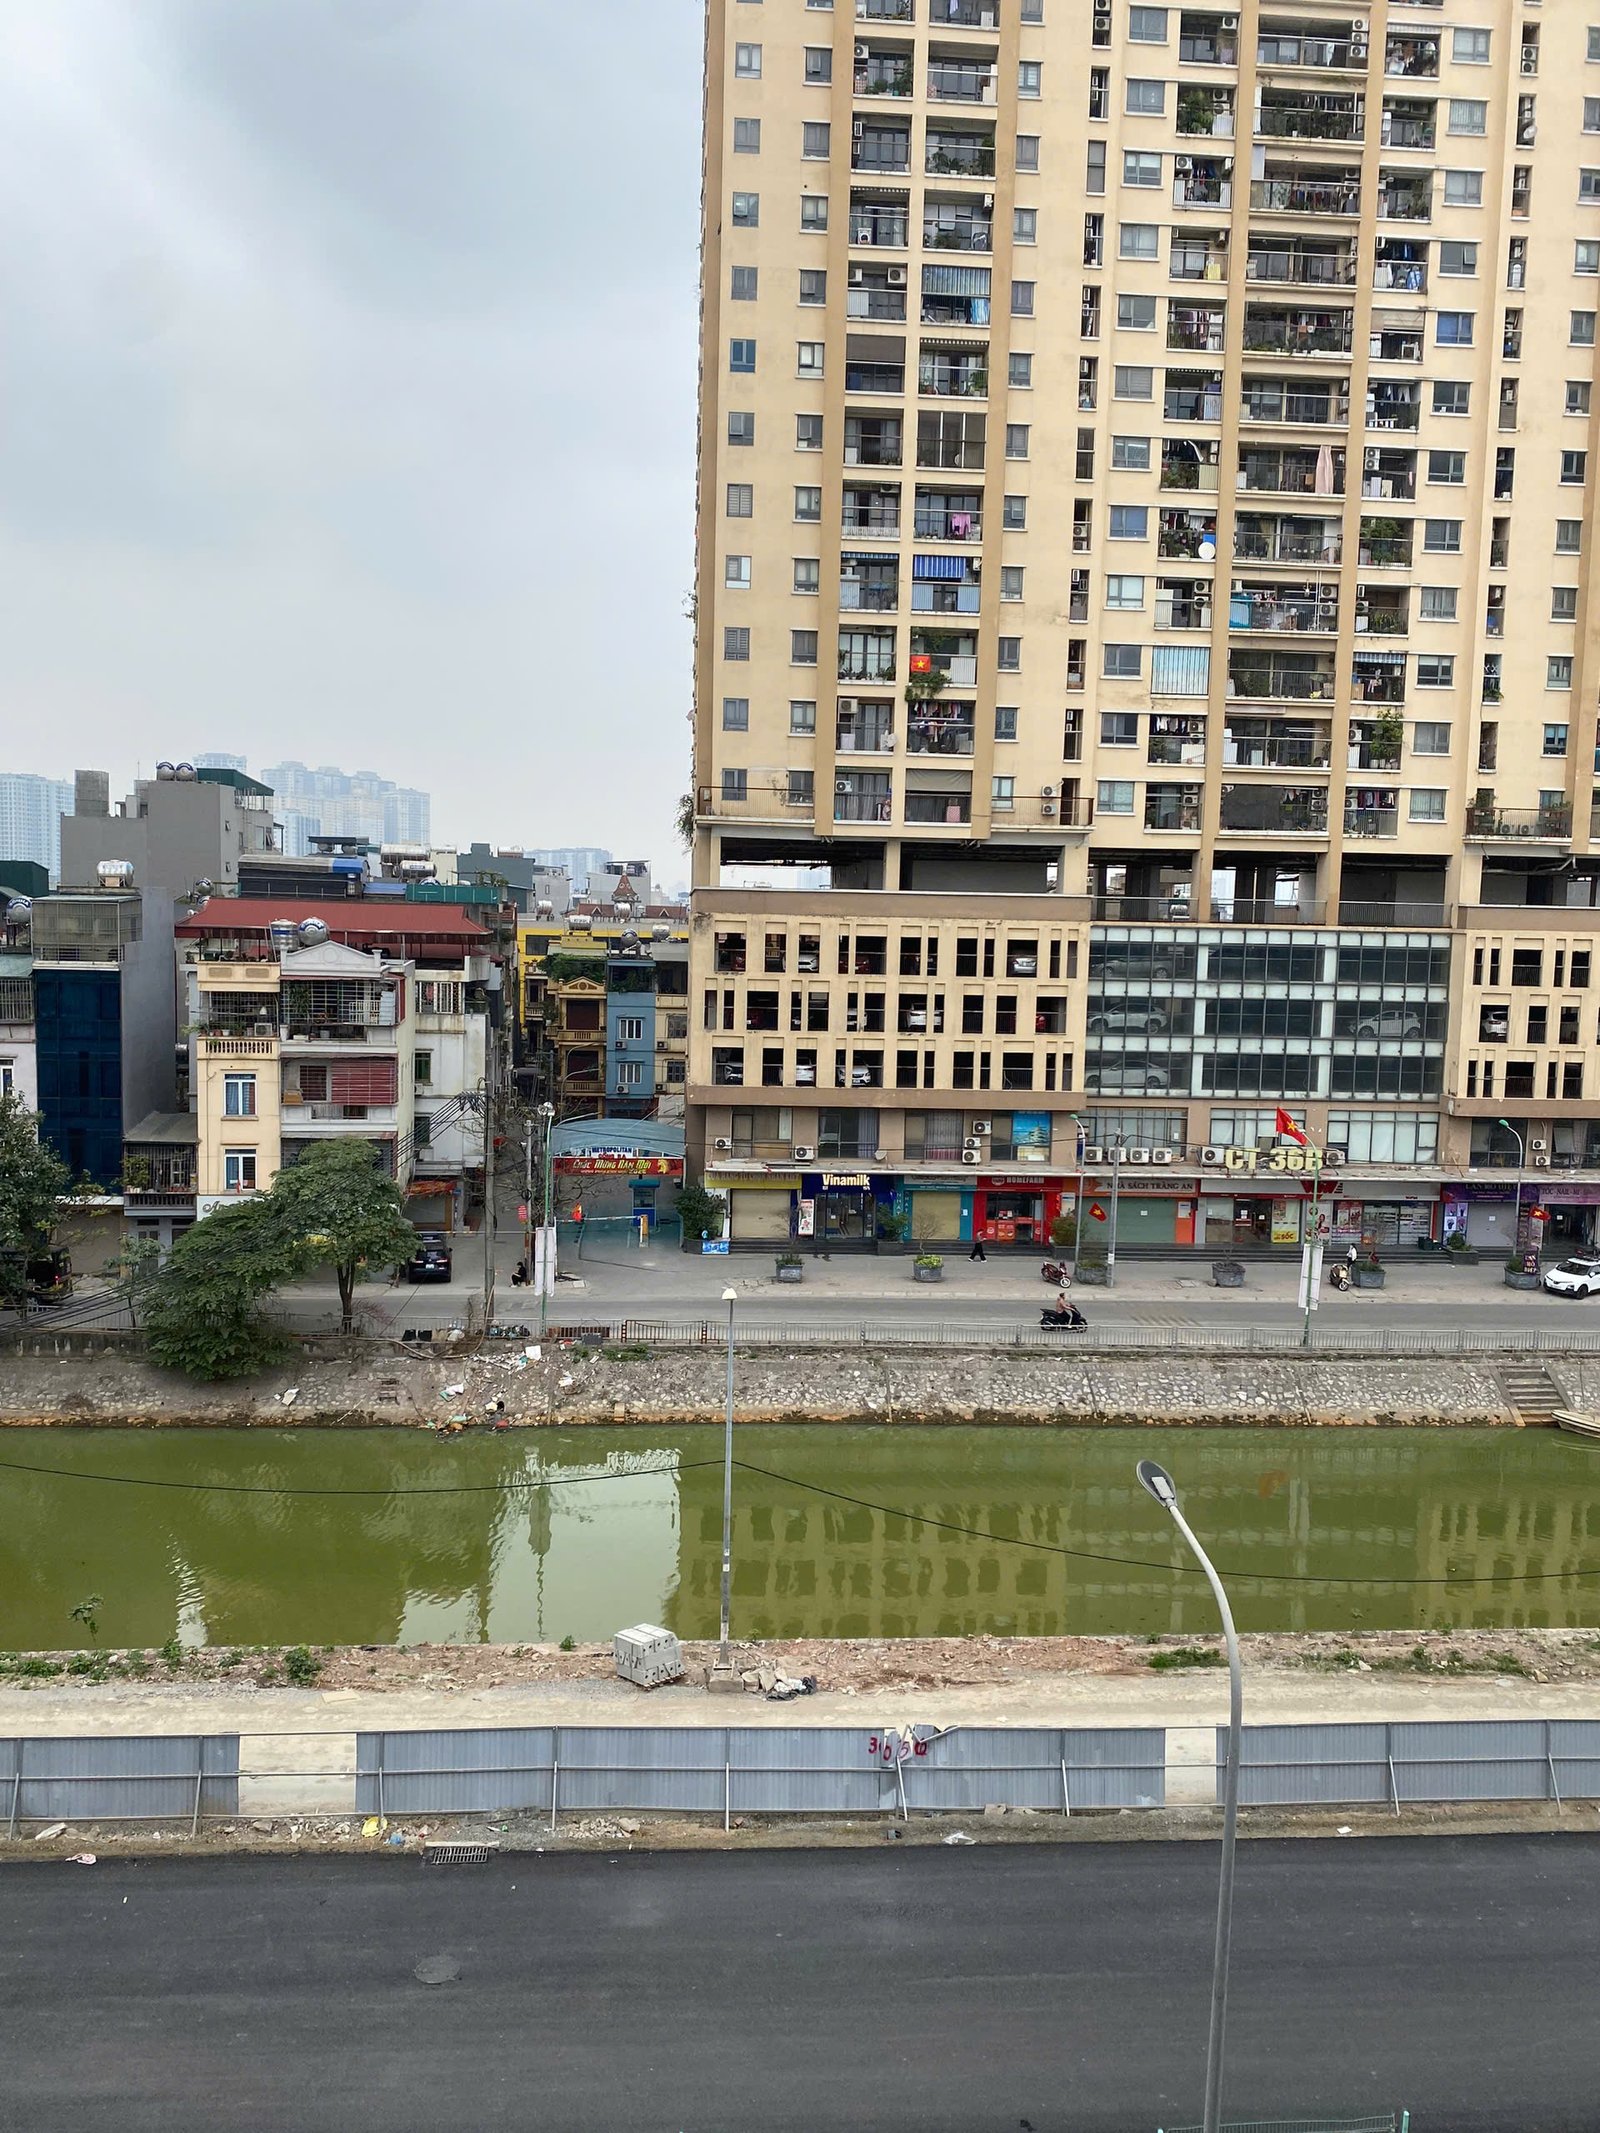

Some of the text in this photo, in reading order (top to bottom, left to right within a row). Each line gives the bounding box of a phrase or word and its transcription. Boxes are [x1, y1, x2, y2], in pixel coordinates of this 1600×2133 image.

[1225, 1147, 1323, 1171] CT 36B
[822, 1173, 871, 1186] Vinamilk
[1127, 1181, 1149, 1190] SÁCH
